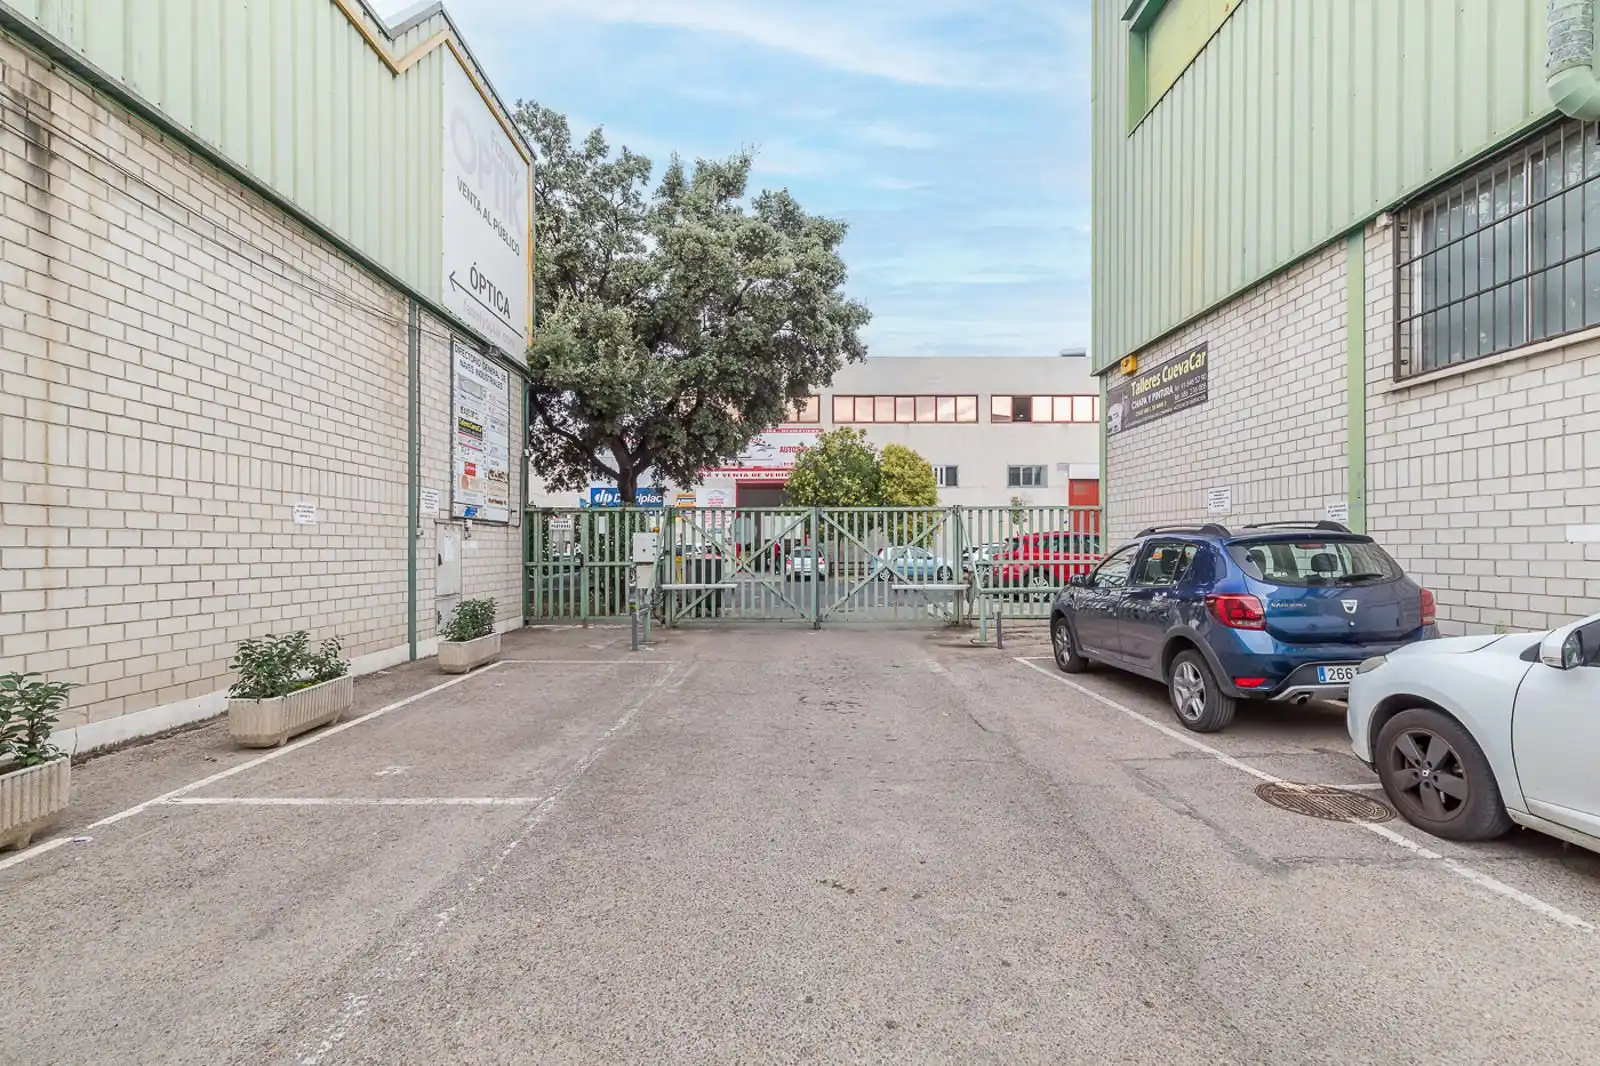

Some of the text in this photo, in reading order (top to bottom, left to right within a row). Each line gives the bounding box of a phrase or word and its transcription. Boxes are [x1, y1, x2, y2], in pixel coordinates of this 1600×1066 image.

[457, 175, 520, 257] VENTA AL PÚBLICO
[470, 262, 511, 319] ÓPTICA
[1130, 371, 1161, 397] Talleres
[1162, 351, 1207, 383] CuevaCar
[1131, 396, 1148, 410] CHAPA
[1152, 385, 1174, 401] PINTURA
[594, 489, 613, 506] dp
[1328, 667, 1355, 681] 266
